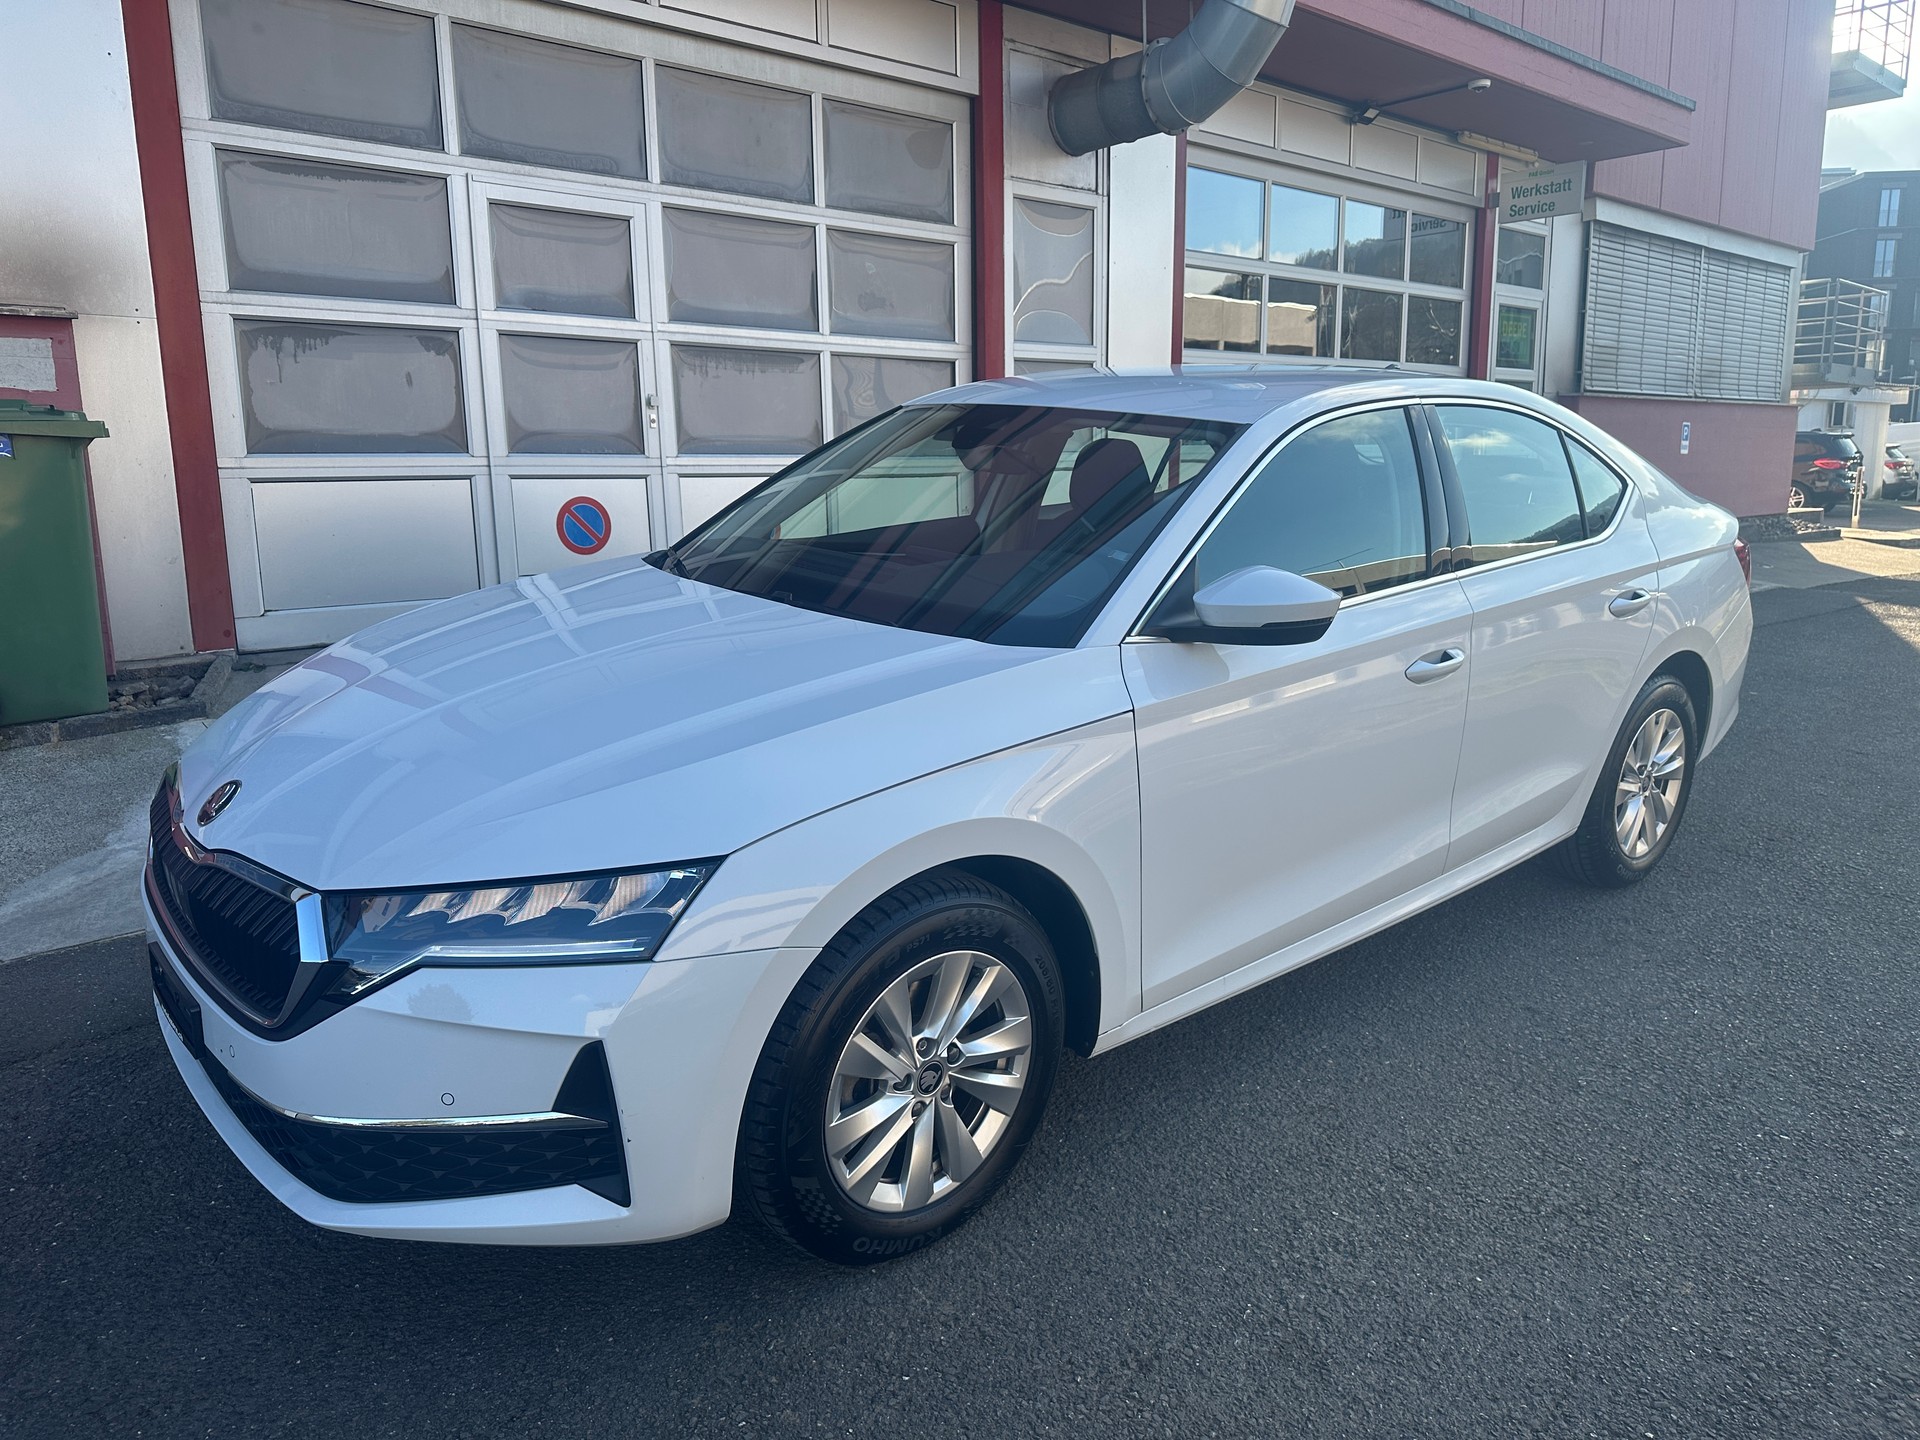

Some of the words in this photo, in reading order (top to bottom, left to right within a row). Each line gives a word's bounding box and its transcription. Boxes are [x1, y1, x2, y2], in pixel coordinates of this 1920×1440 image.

[1511, 178, 1572, 200] Werkstatt
[1509, 201, 1555, 218] Service
[852, 1226, 942, 1255] KUMHO
